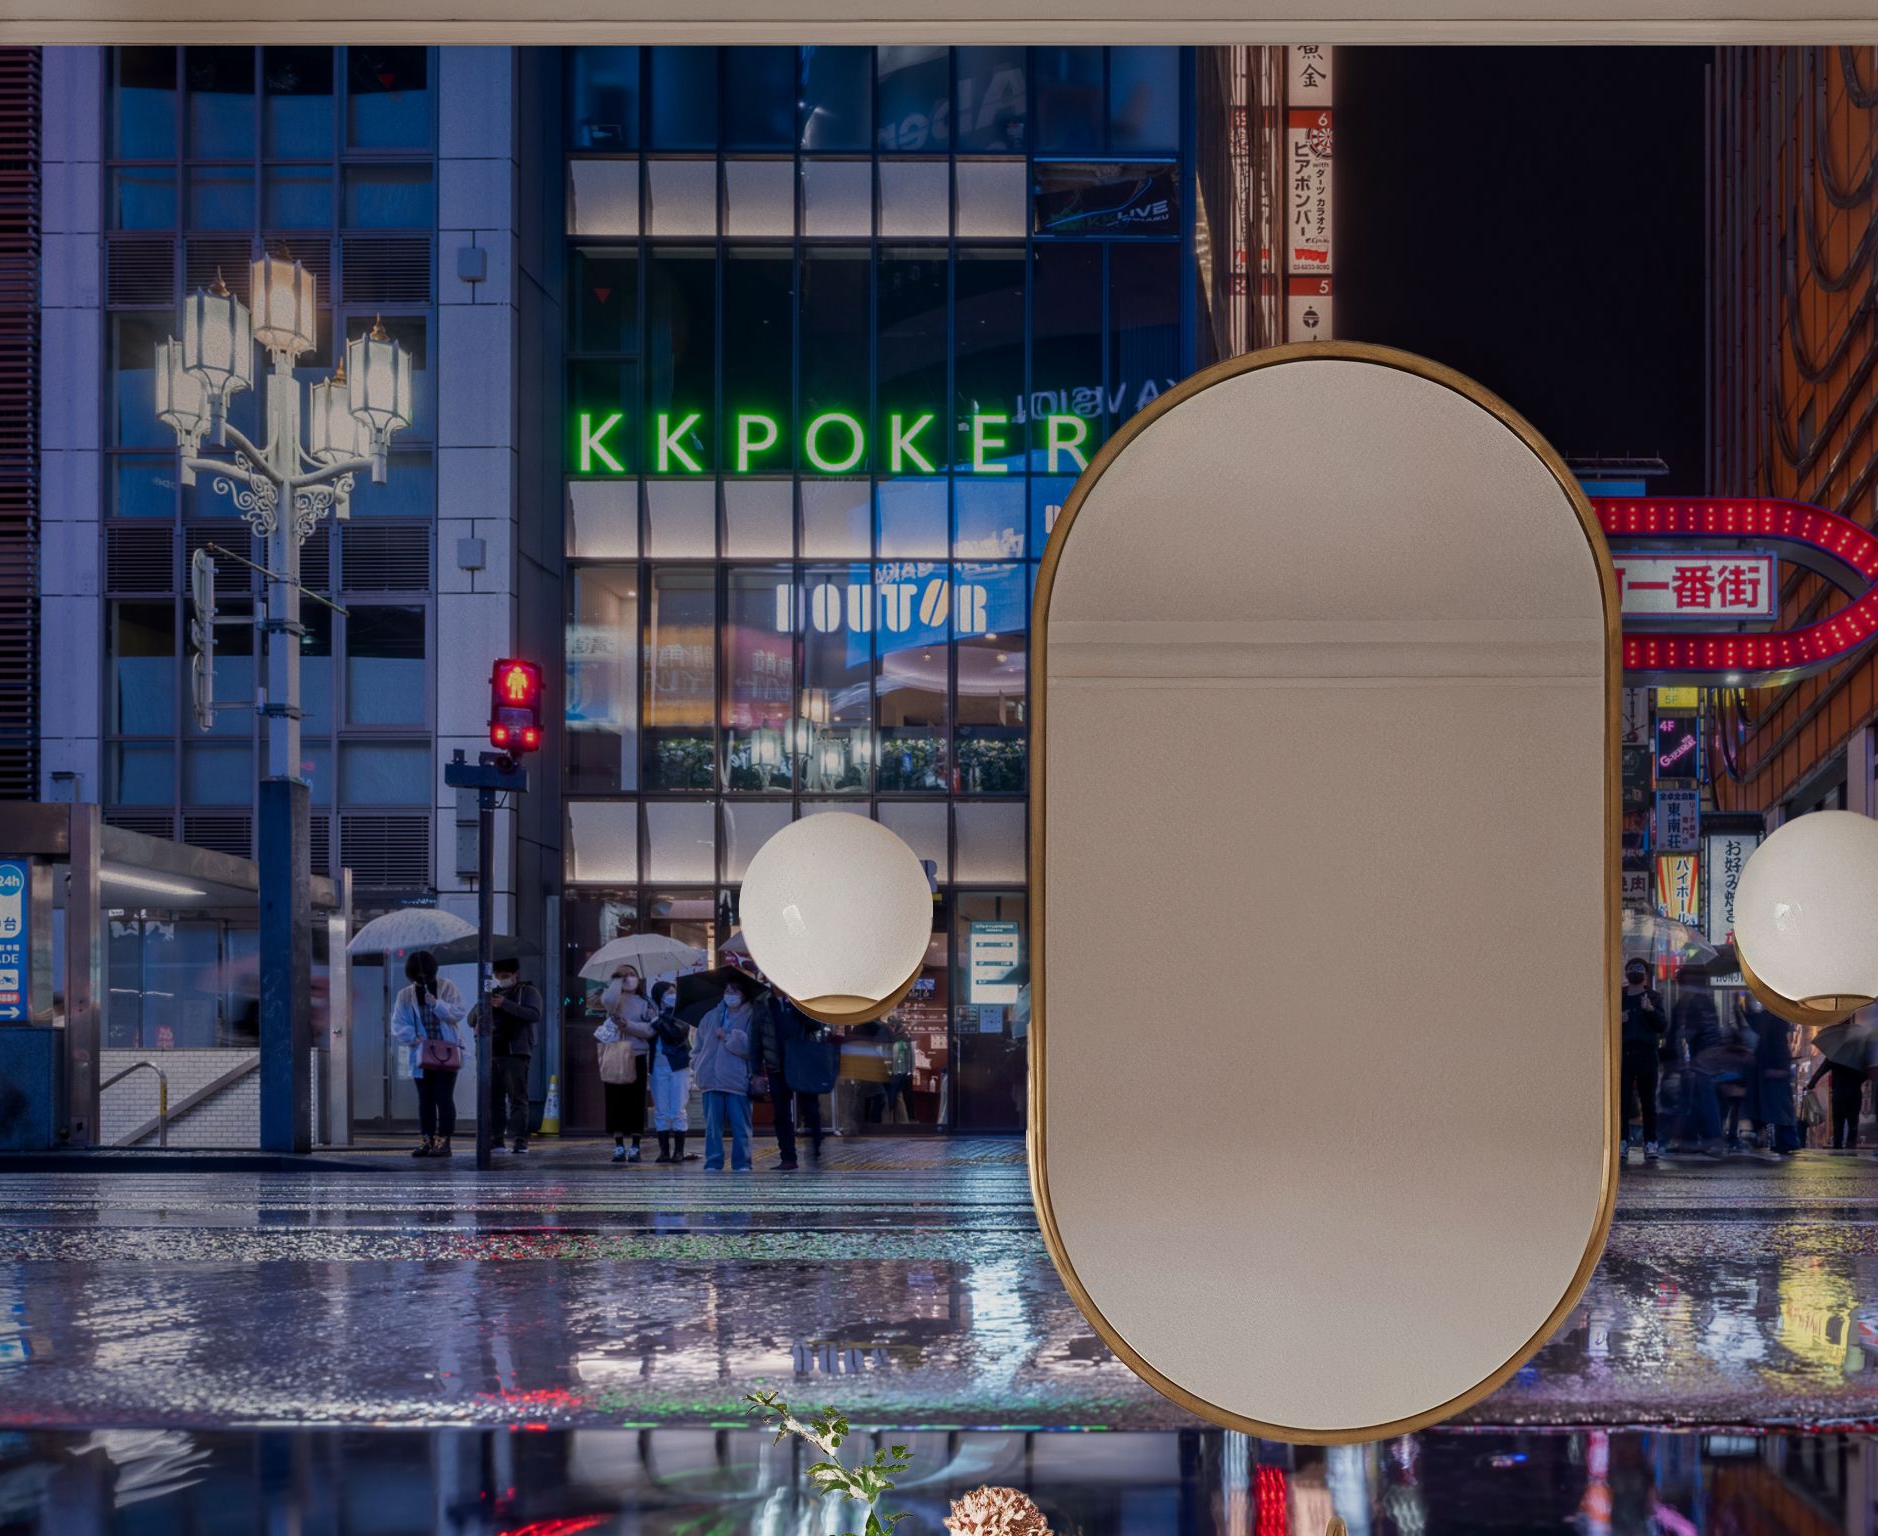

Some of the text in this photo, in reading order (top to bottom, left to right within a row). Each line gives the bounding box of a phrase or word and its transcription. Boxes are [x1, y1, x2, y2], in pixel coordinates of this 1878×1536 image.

[1317, 111, 1329, 127] 6
[1316, 199, 1326, 235] カラオケ
[1318, 279, 1329, 294] 5
[577, 411, 1091, 474] KKPOKER
[1614, 565, 1761, 609] 一番街
[1659, 720, 1676, 733] 4F
[1667, 802, 1682, 850] 東南荘
